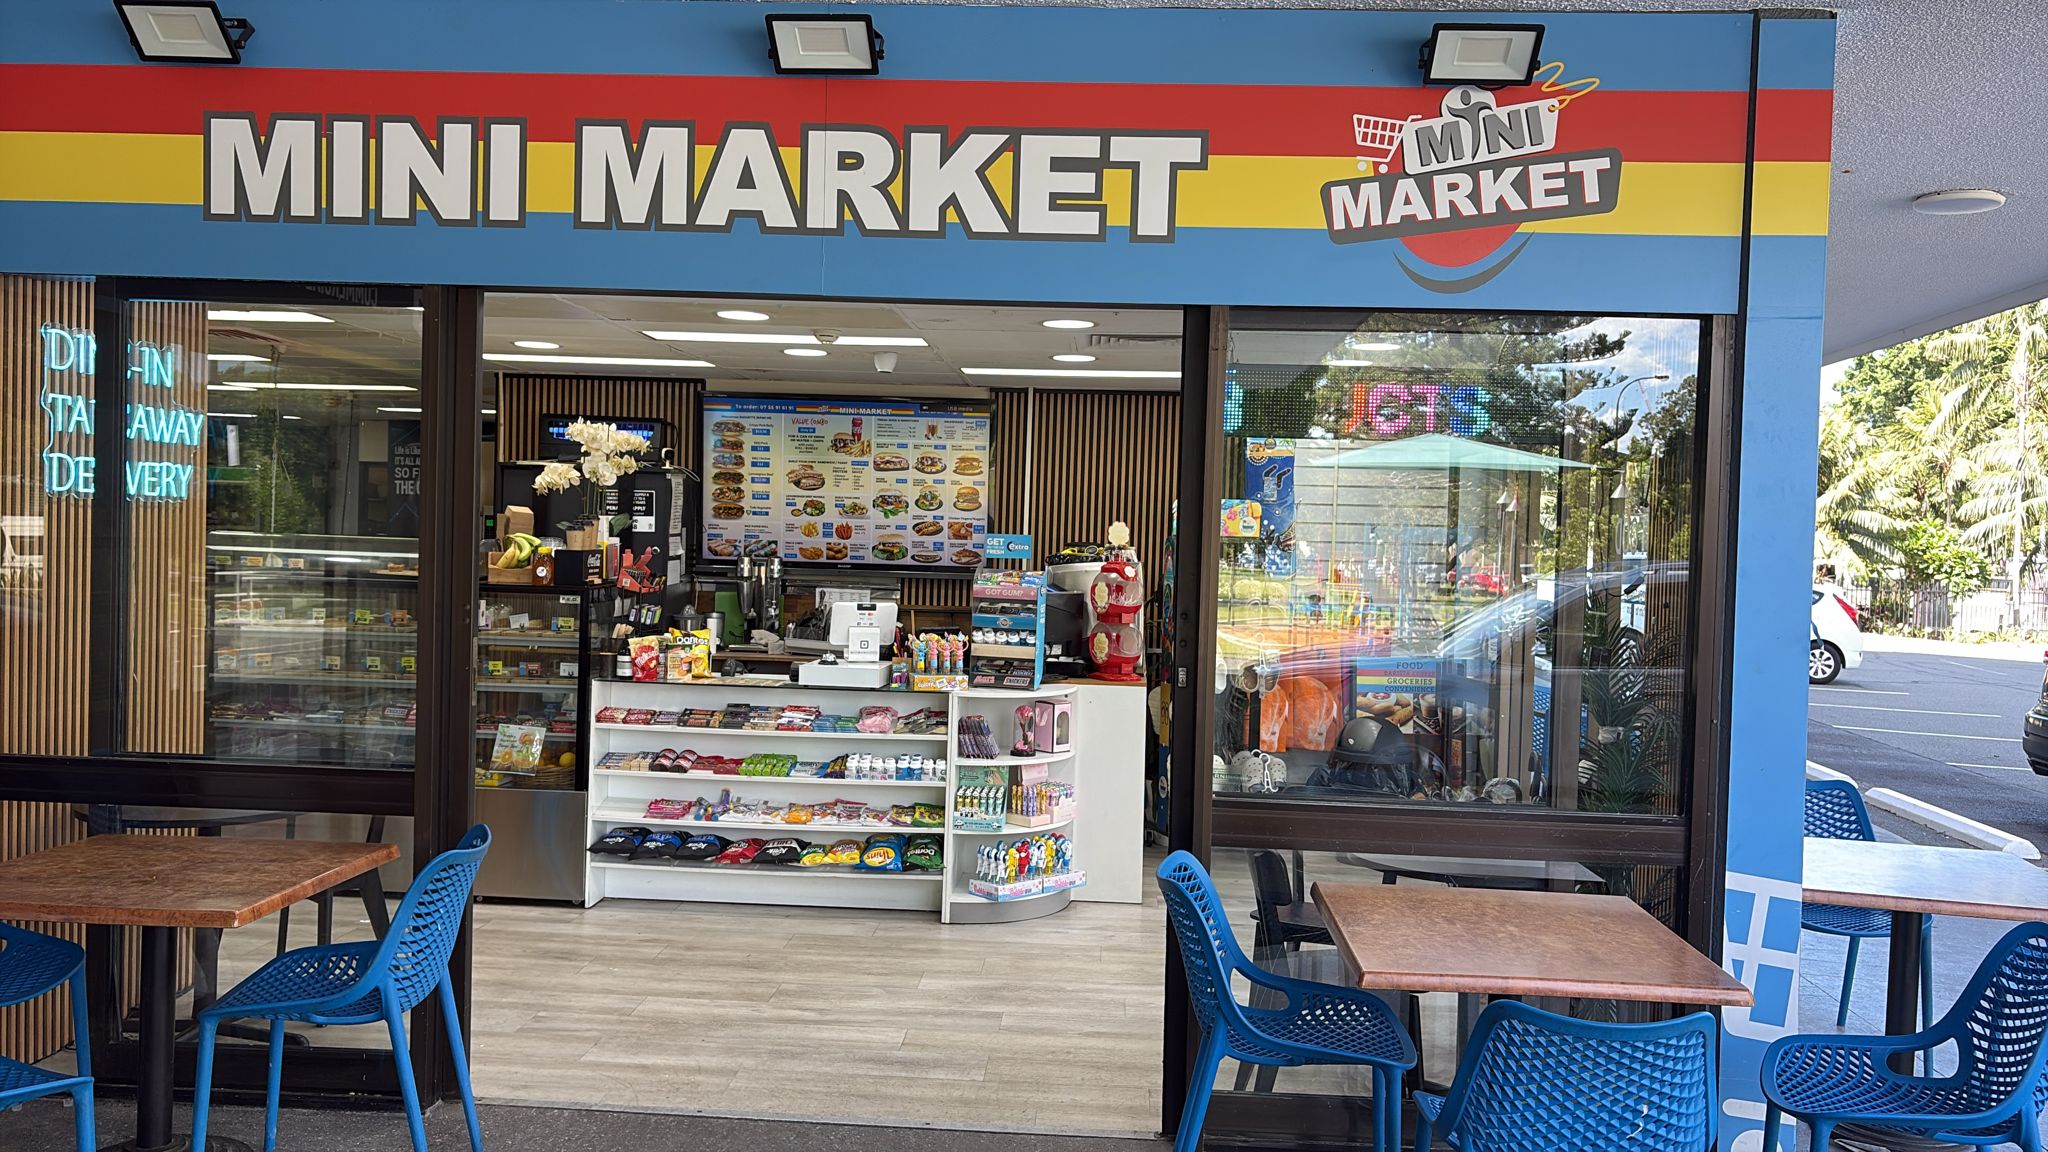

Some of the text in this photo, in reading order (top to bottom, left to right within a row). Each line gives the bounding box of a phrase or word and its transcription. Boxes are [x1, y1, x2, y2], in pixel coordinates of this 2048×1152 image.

[1415, 105, 1545, 166] MINI
[206, 116, 1206, 240] MINI MARKET
[1329, 156, 1612, 231] MARKET
[45, 453, 193, 498] DEVERY
[394, 467, 410, 478] SO
[394, 480, 414, 495] THE
[986, 538, 1005, 546] GET
[1396, 662, 1424, 670] FOOD
[1386, 678, 1432, 686] GROCERIES
